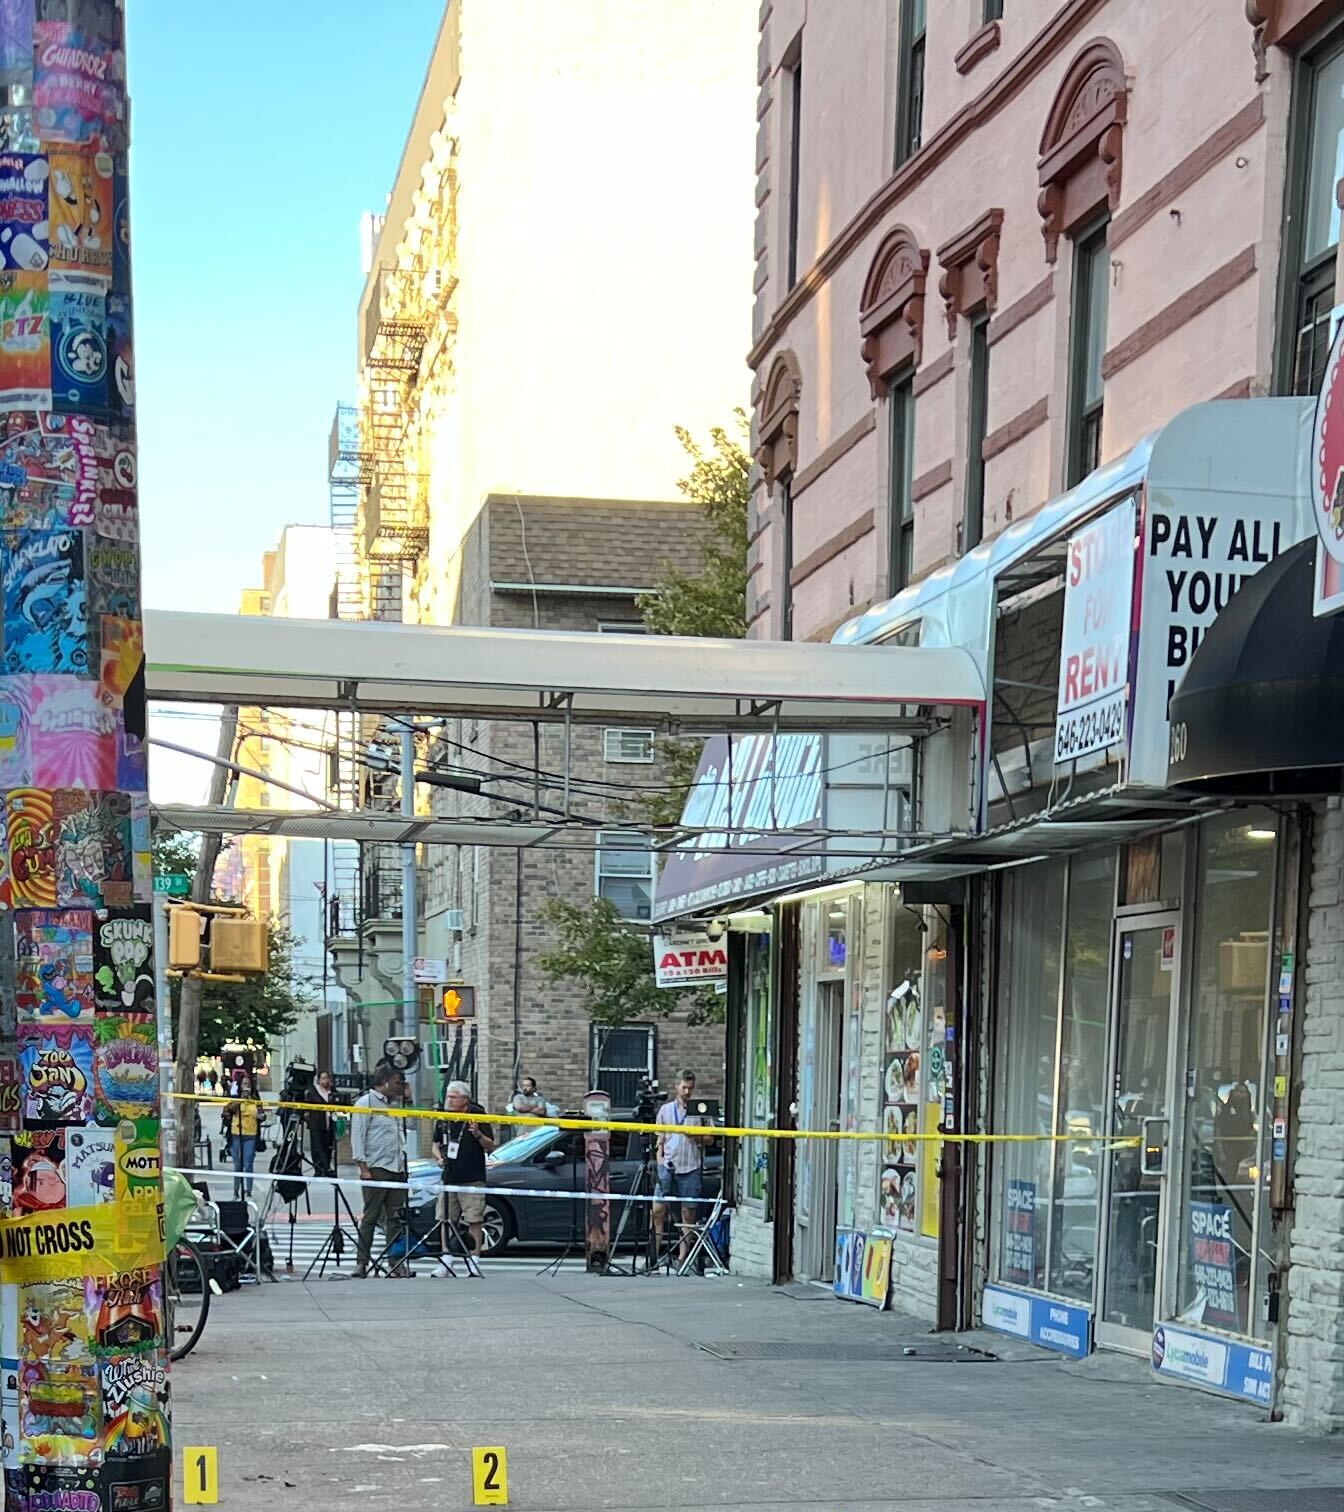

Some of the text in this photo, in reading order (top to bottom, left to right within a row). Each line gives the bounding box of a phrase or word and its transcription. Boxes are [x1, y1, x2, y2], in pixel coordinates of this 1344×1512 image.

[1151, 513, 1281, 563] PAY ALL
[1166, 570, 1255, 615] YOU
[1064, 639, 1123, 704] RENT
[1056, 700, 1123, 758] 646-223-0429
[154, 877, 172, 890] 139
[102, 920, 154, 946] SKUNK
[659, 949, 727, 968] ATM
[1007, 1187, 1034, 1210] SPACE
[7, 1220, 95, 1258] NOT CROSS
[1191, 1210, 1231, 1238] SPACE
[196, 1454, 207, 1491] 1
[483, 1452, 500, 1491] 2
